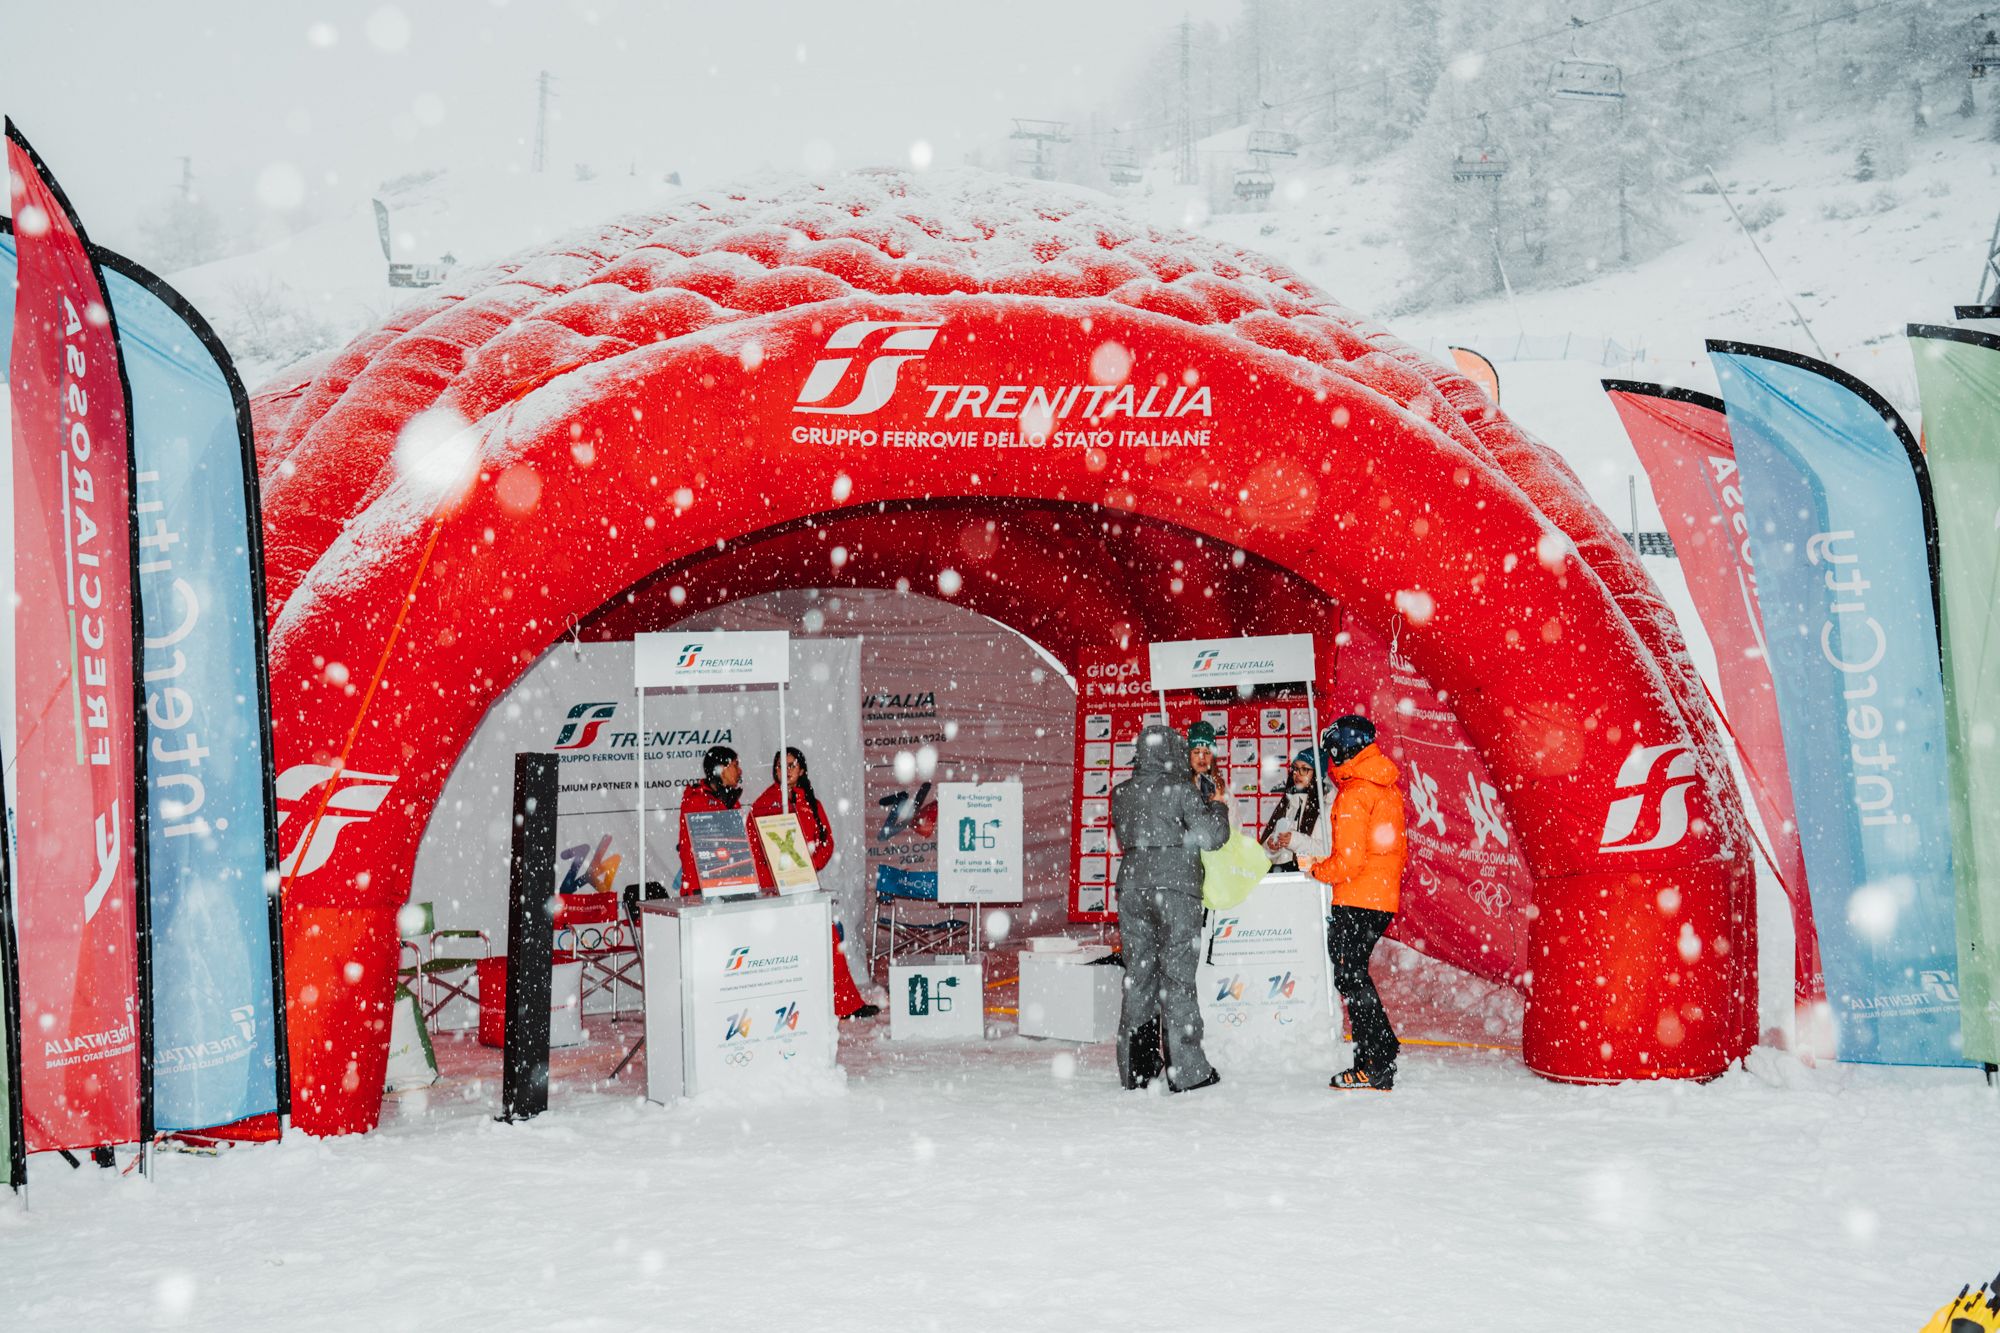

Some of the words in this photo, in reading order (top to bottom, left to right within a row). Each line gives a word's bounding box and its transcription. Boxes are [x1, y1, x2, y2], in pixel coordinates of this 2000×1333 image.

[924, 385, 1212, 418] TRENITALIA
[791, 426, 878, 446] GRUPPO
[882, 429, 978, 447] FERROVIE
[984, 431, 1046, 448] DELLO
[1054, 430, 1115, 447] STATO
[1119, 429, 1211, 446] ITALIANE
[699, 658, 753, 667] TRENITALIA
[1216, 660, 1274, 671] TRENITALIA
[1086, 663, 1141, 678] GIOCA
[1098, 682, 1152, 695] VIAGG
[1130, 699, 1178, 708] destinaone
[1179, 699, 1192, 708] per
[897, 711, 937, 719] ITALIANE
[610, 729, 733, 748] TRENITALIA
[592, 753, 635, 762] FERROVIE
[666, 751, 693, 760] STATO
[558, 784, 588, 793] EMIUM
[591, 782, 632, 792] PARTNER
[957, 793, 1002, 802] Re-Charging
[867, 844, 909, 857] MILANO
[912, 842, 938, 852] COR
[899, 854, 925, 865] 2026
[1237, 927, 1292, 937] TRENITALIA
[747, 955, 799, 969] TRENITALIA
